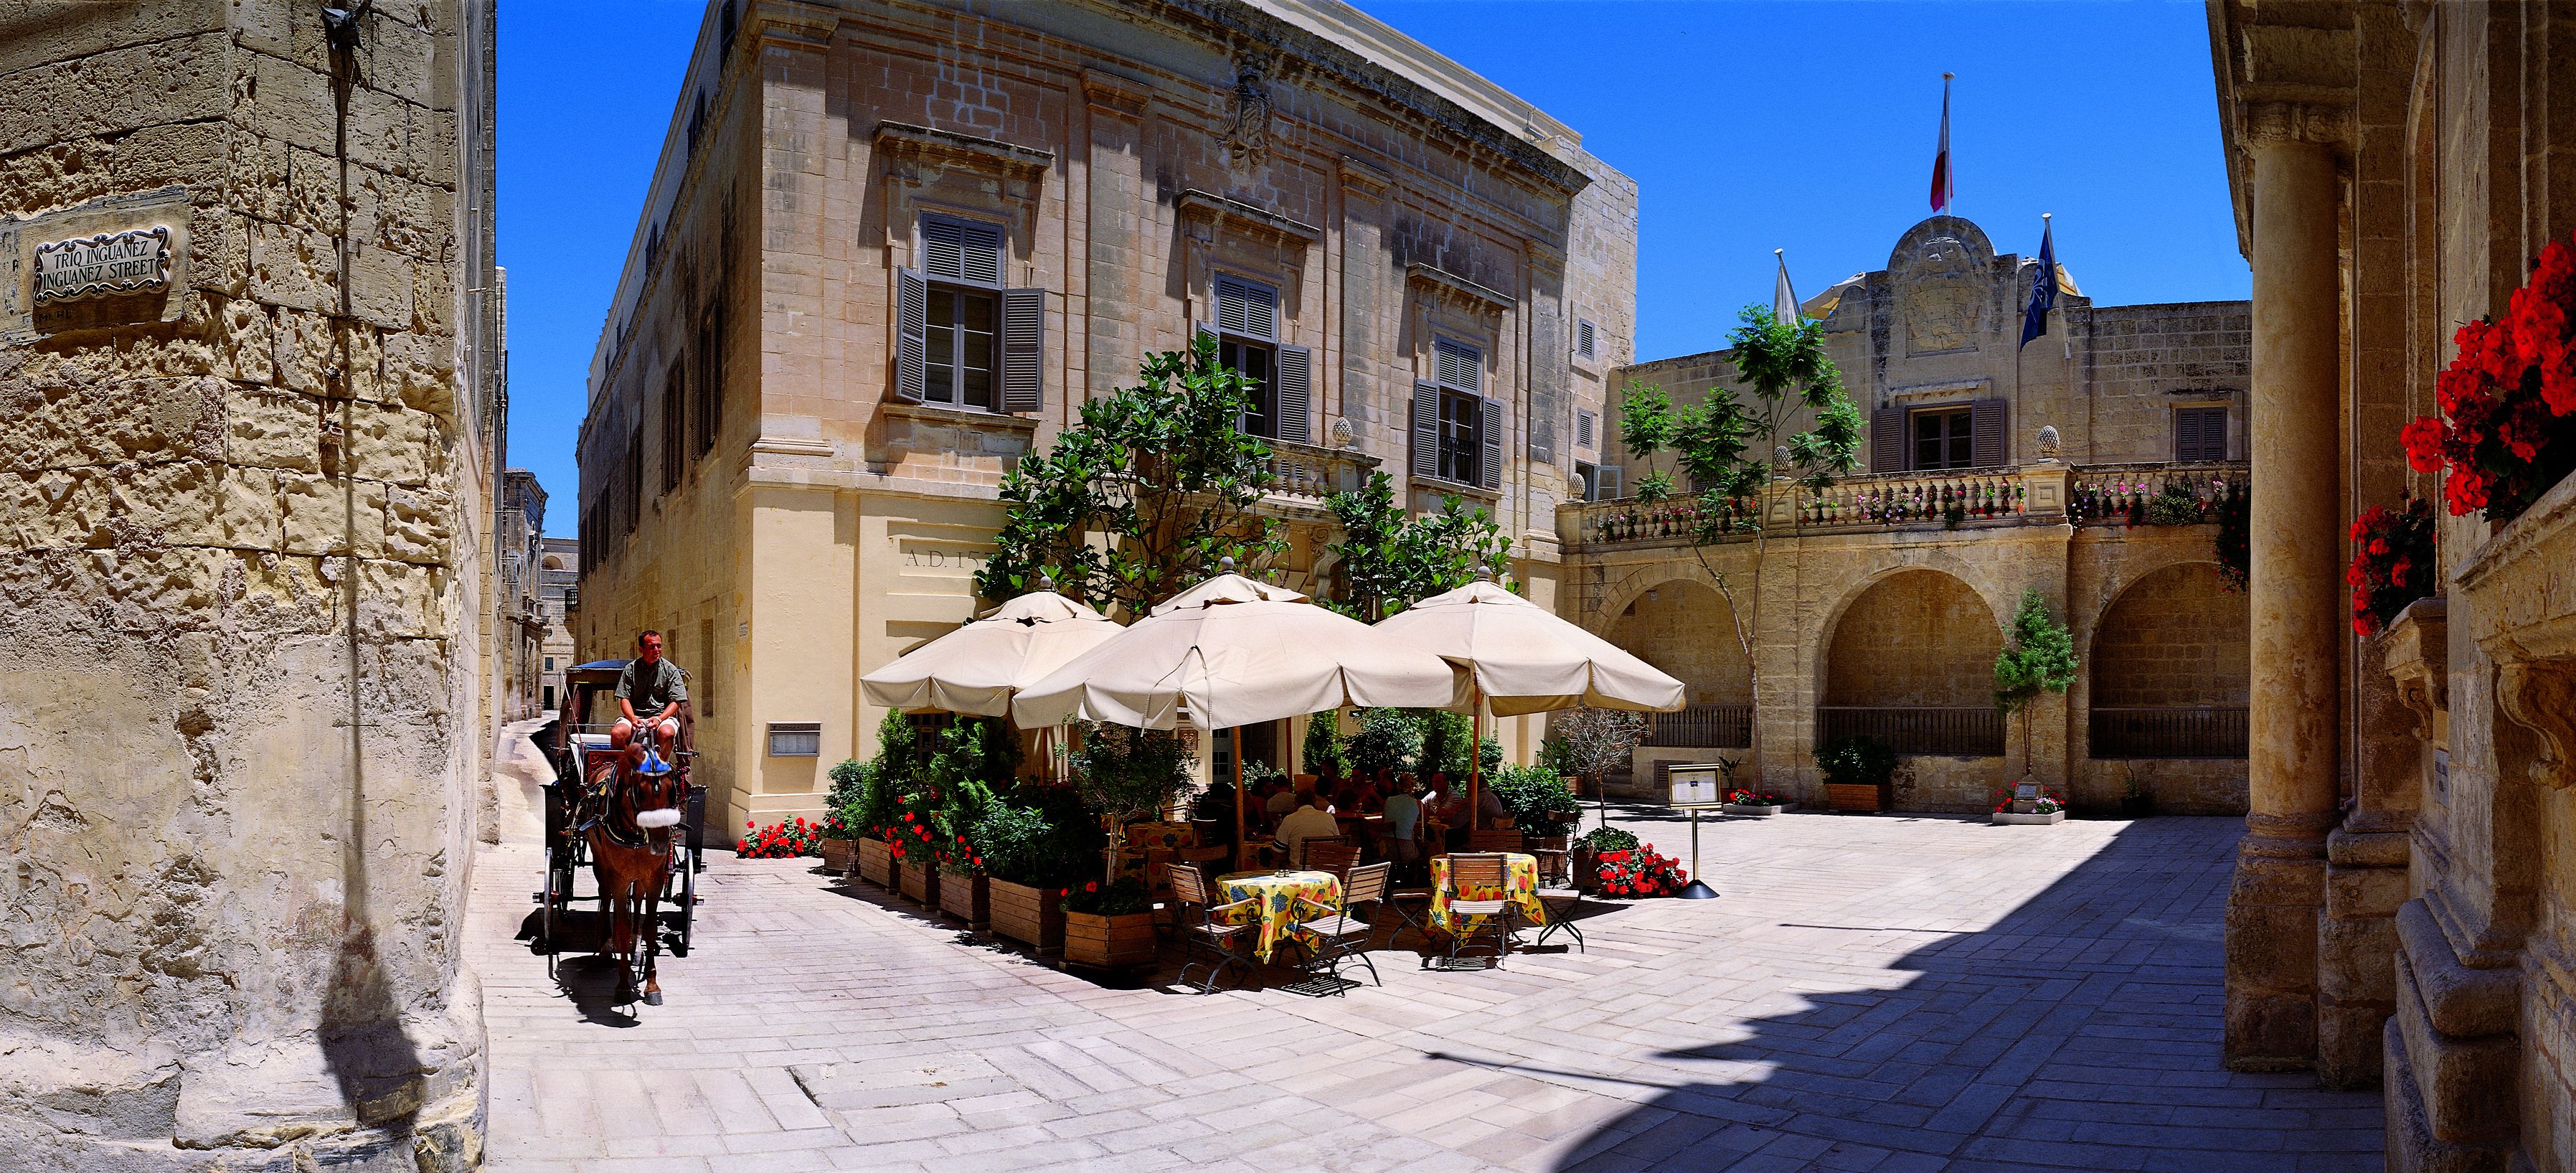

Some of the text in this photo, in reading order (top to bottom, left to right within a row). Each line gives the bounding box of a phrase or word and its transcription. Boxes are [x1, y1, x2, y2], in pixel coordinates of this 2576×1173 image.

[54, 240, 149, 270] TRIQ INGUANEZ
[42, 258, 156, 289] INGUANEZ STREET
[905, 548, 948, 568] A.D.
